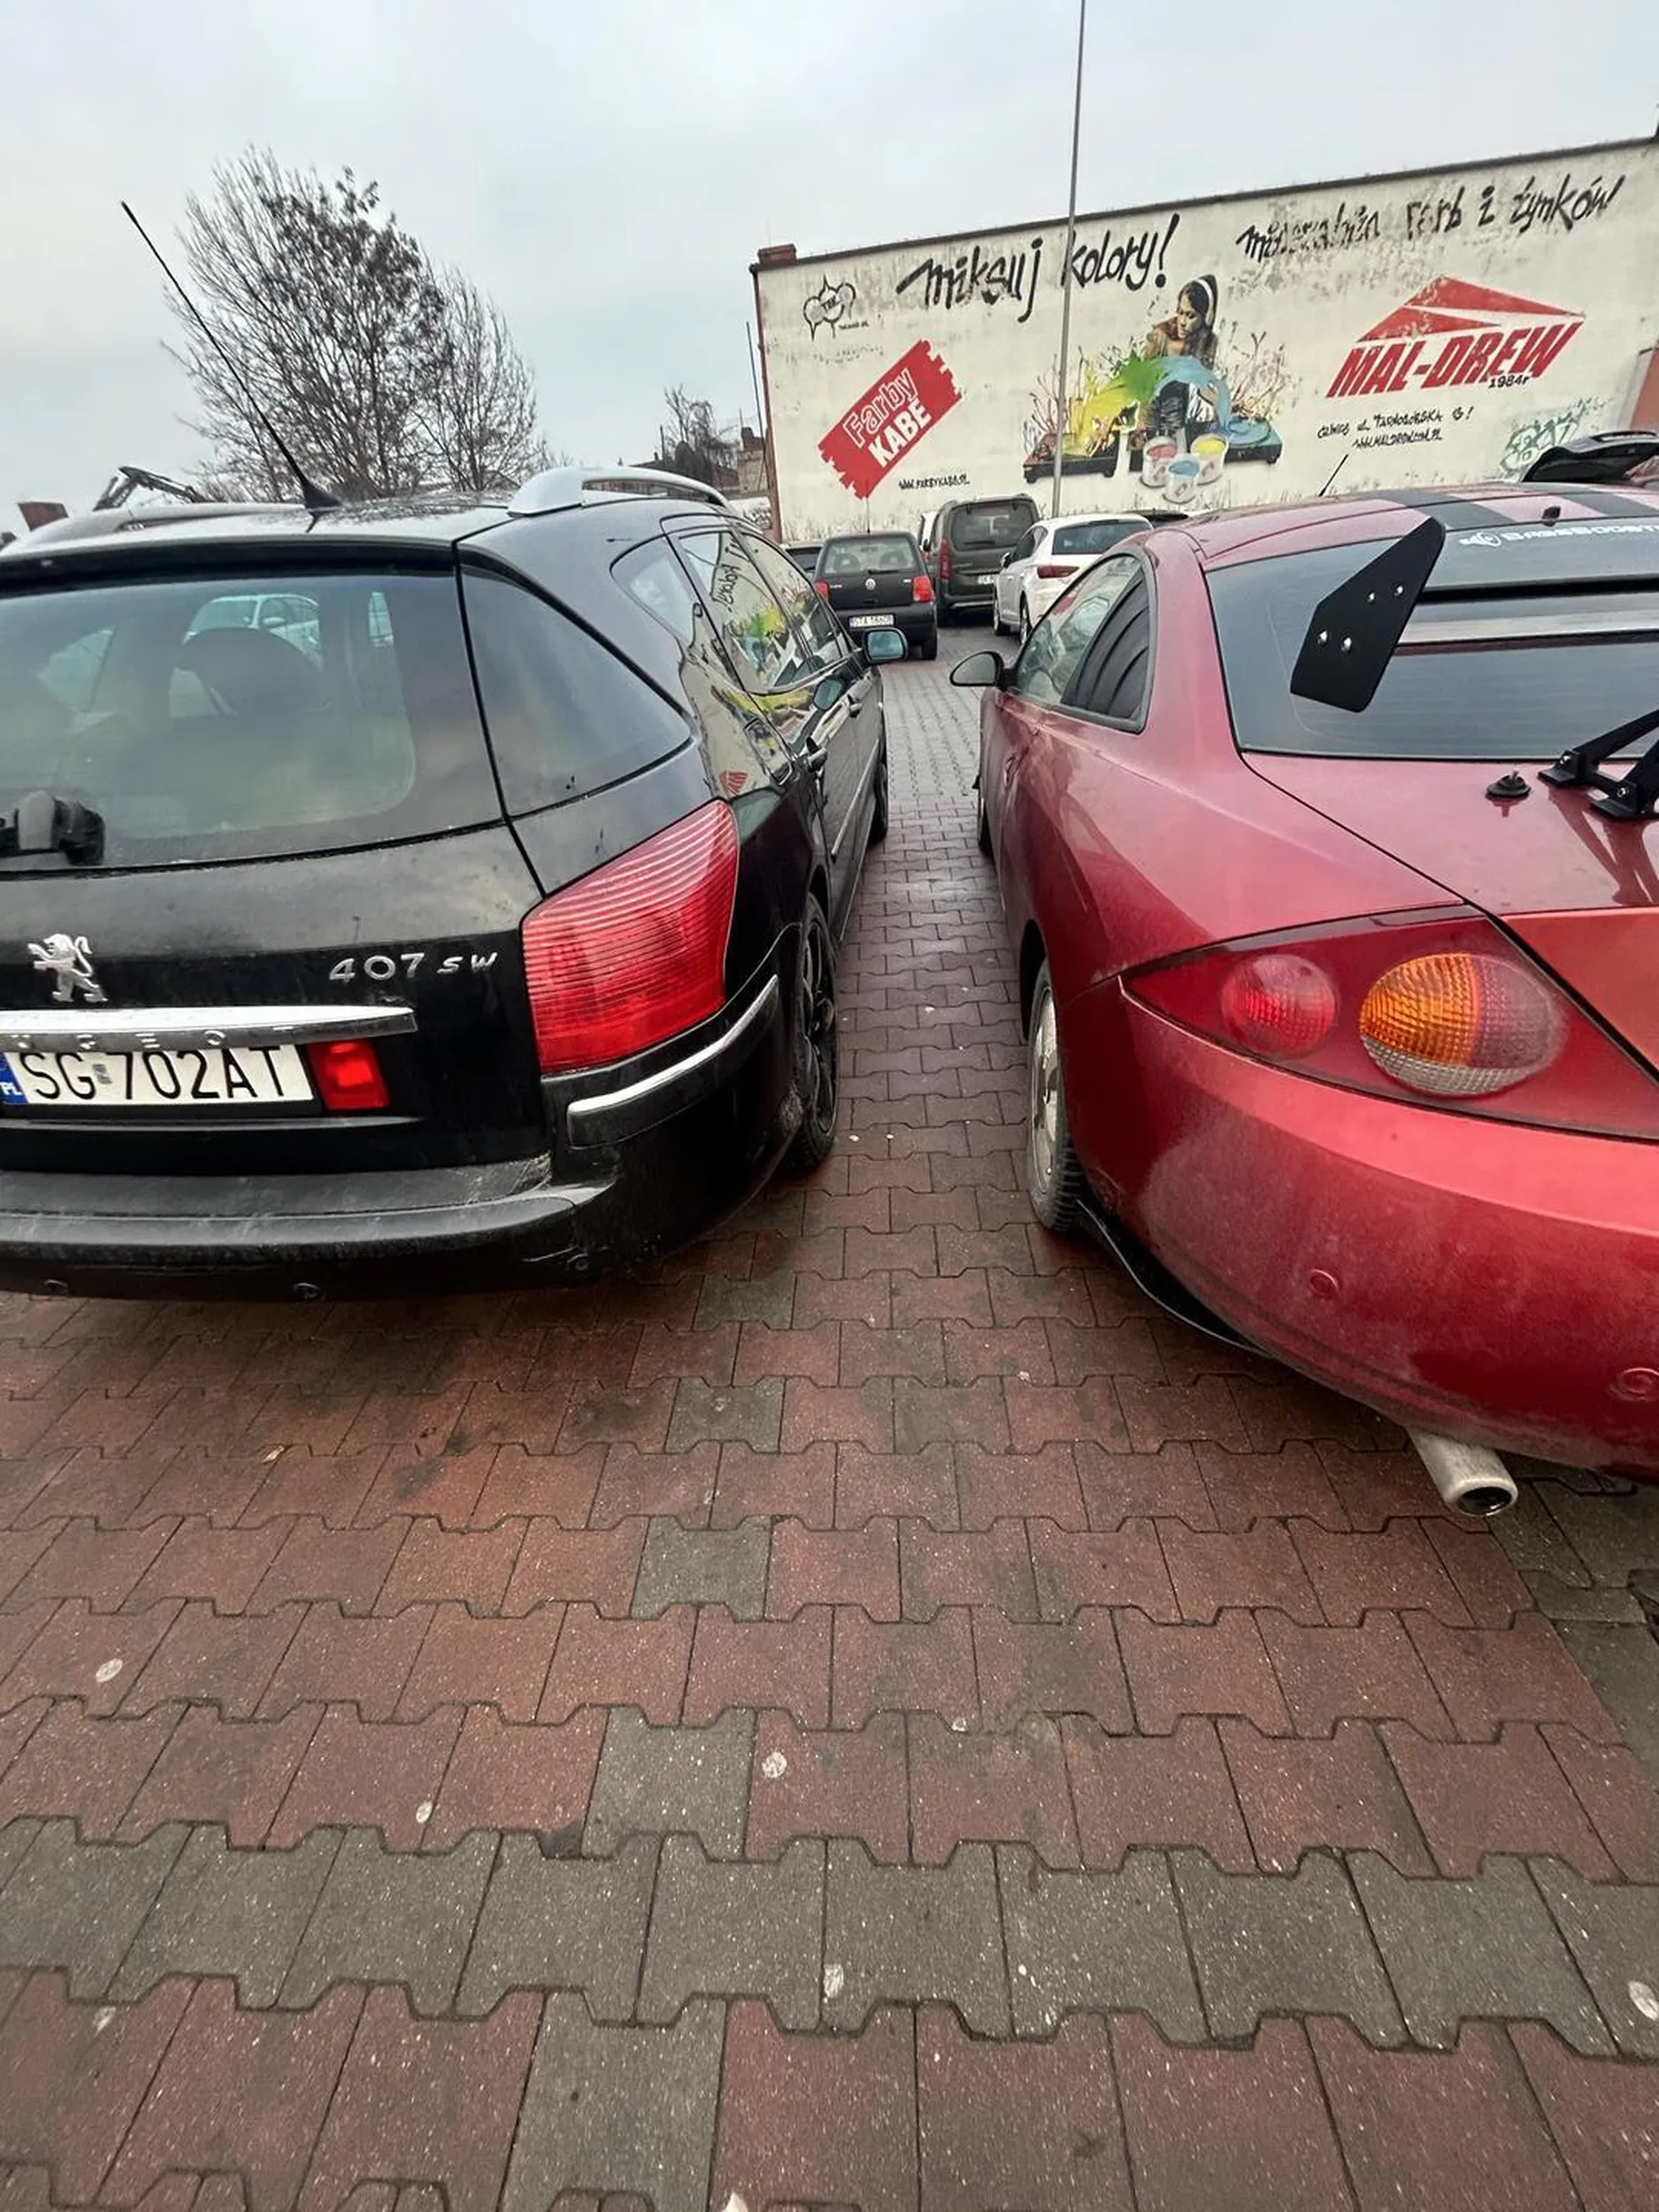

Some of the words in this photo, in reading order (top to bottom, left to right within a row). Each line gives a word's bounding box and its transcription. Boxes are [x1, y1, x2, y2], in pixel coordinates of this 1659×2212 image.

[1326, 321, 1584, 398] MAL-DREW
[1488, 374, 1530, 389] 1984r
[842, 367, 918, 449] Farby
[867, 398, 932, 468] KABE
[329, 952, 425, 984] 407
[436, 951, 498, 974] SW
[19, 1051, 96, 1100] SG
[105, 1045, 287, 1101] 702AT
